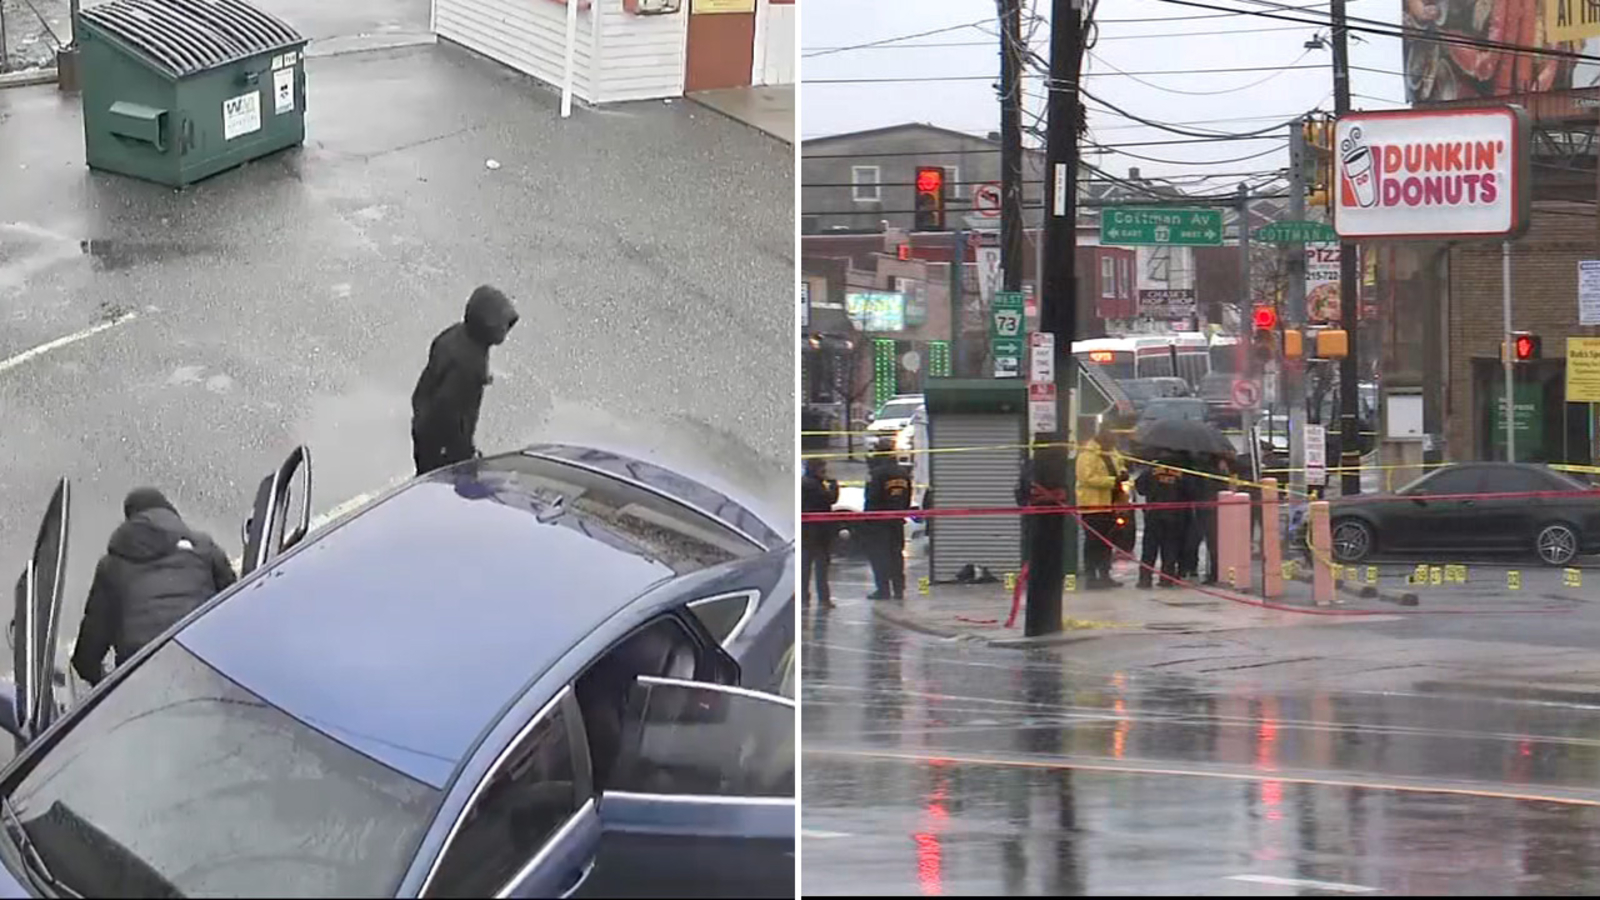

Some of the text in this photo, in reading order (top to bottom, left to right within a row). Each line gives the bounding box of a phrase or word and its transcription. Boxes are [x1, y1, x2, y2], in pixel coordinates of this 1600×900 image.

[1384, 140, 1503, 173] DUNKIN'
[1383, 173, 1497, 206] DONUTS
[1114, 212, 1209, 225] Cottman Av
[997, 316, 1016, 331] 73
